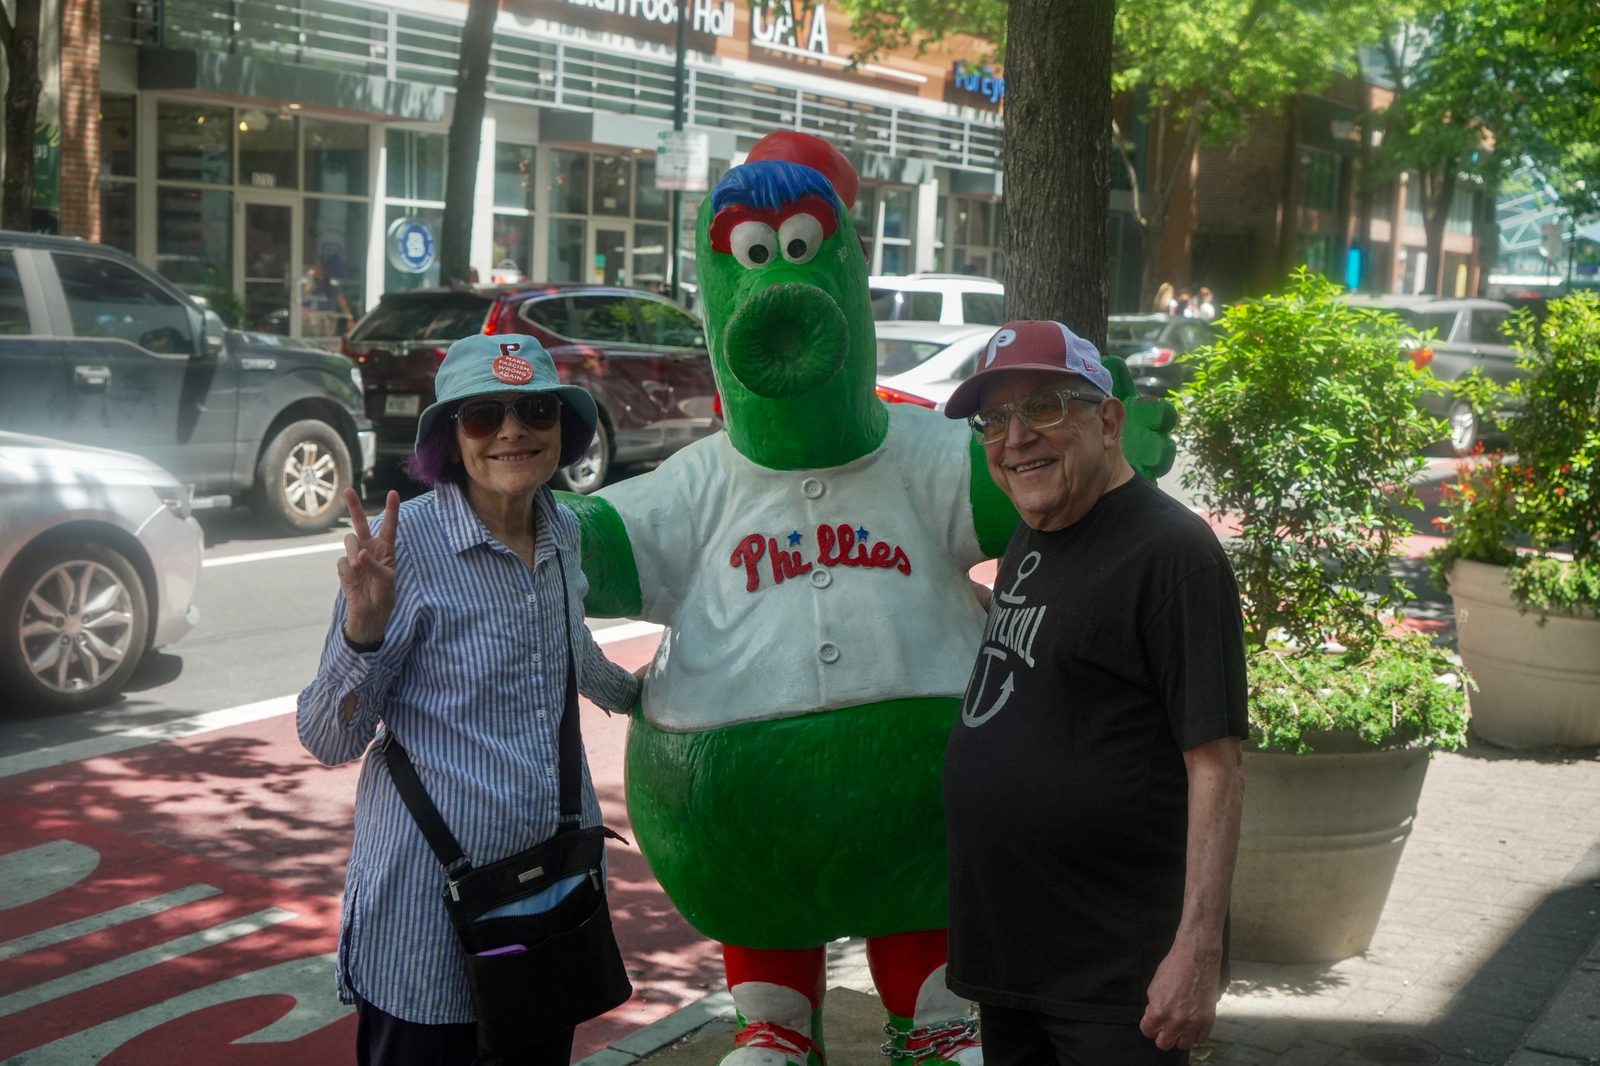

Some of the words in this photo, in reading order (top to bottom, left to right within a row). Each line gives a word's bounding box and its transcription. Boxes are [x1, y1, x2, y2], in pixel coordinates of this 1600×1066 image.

[693, 0, 736, 37] Hall
[752, 0, 830, 54] CAVA
[505, 356, 527, 366] MAKE
[984, 329, 1017, 368] P
[498, 359, 531, 372] FASCISM
[498, 365, 527, 377] WRONG
[499, 371, 523, 381] AGAIN
[729, 523, 913, 593] Phillies
